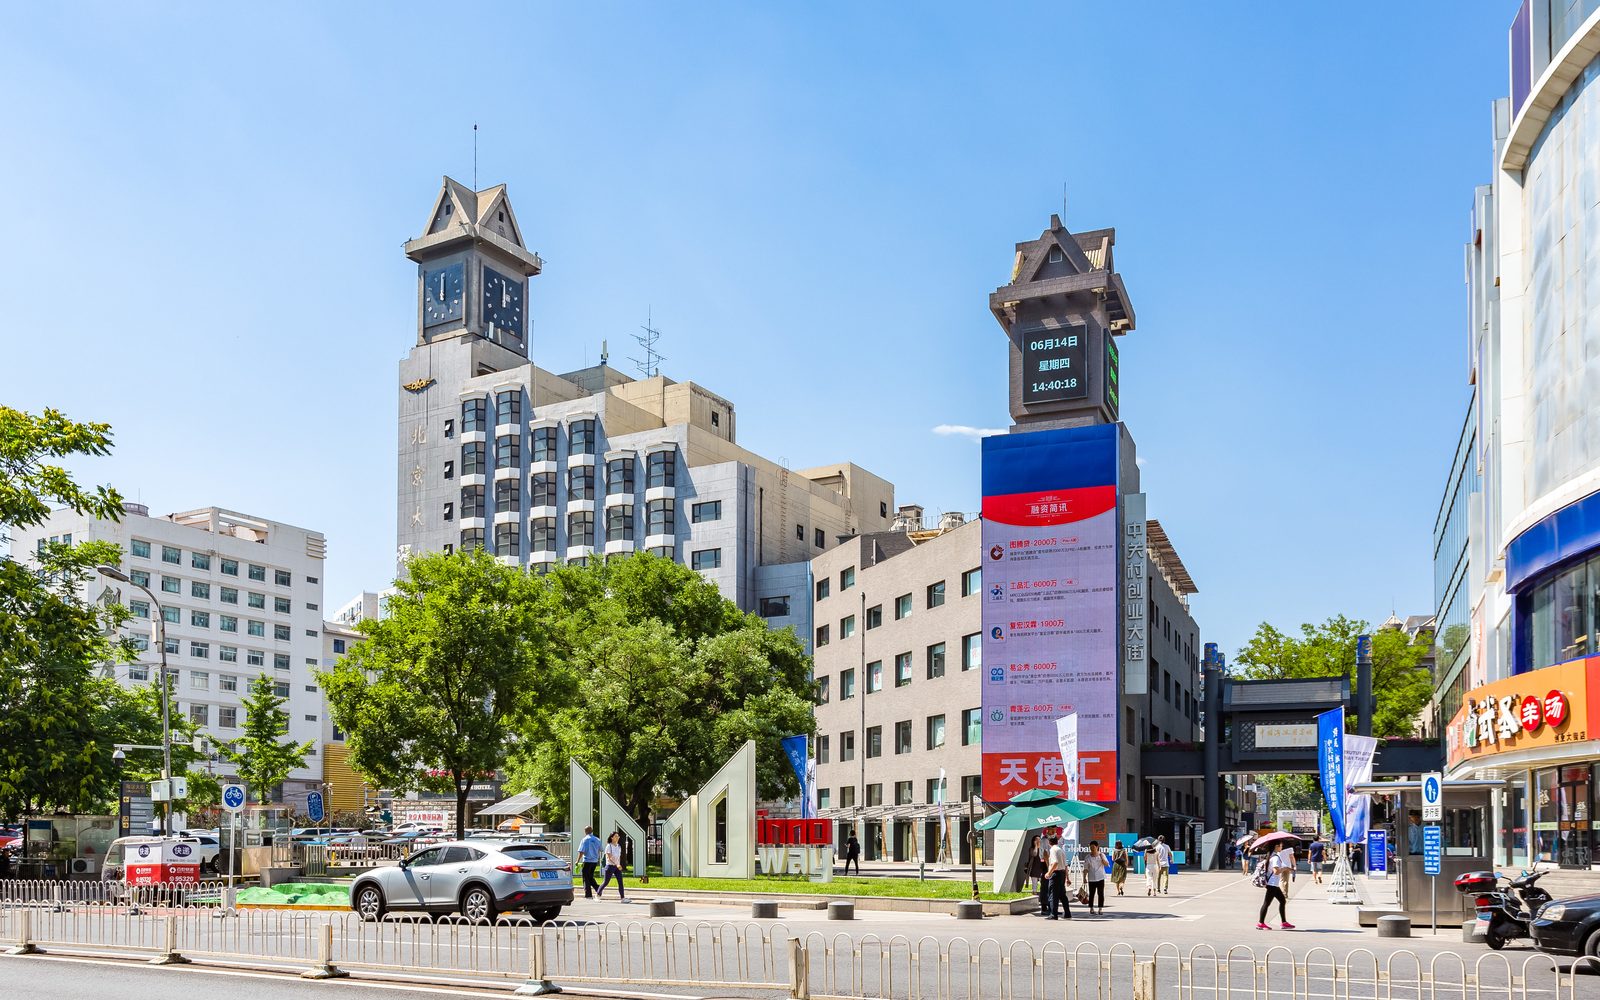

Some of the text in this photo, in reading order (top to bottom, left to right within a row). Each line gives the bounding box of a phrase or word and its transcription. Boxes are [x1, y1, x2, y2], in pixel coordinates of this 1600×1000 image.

[1030, 335, 1078, 351] 06月14日
[1038, 358, 1070, 372] 星期四
[1032, 378, 1077, 393] 14:40:18
[1030, 502, 1068, 515] 融资简讯
[1127, 522, 1144, 662] 中关村创业大街
[1000, 757, 1101, 787] 天使汇
[139, 847, 149, 856] 快递
[173, 846, 190, 855] 快递
